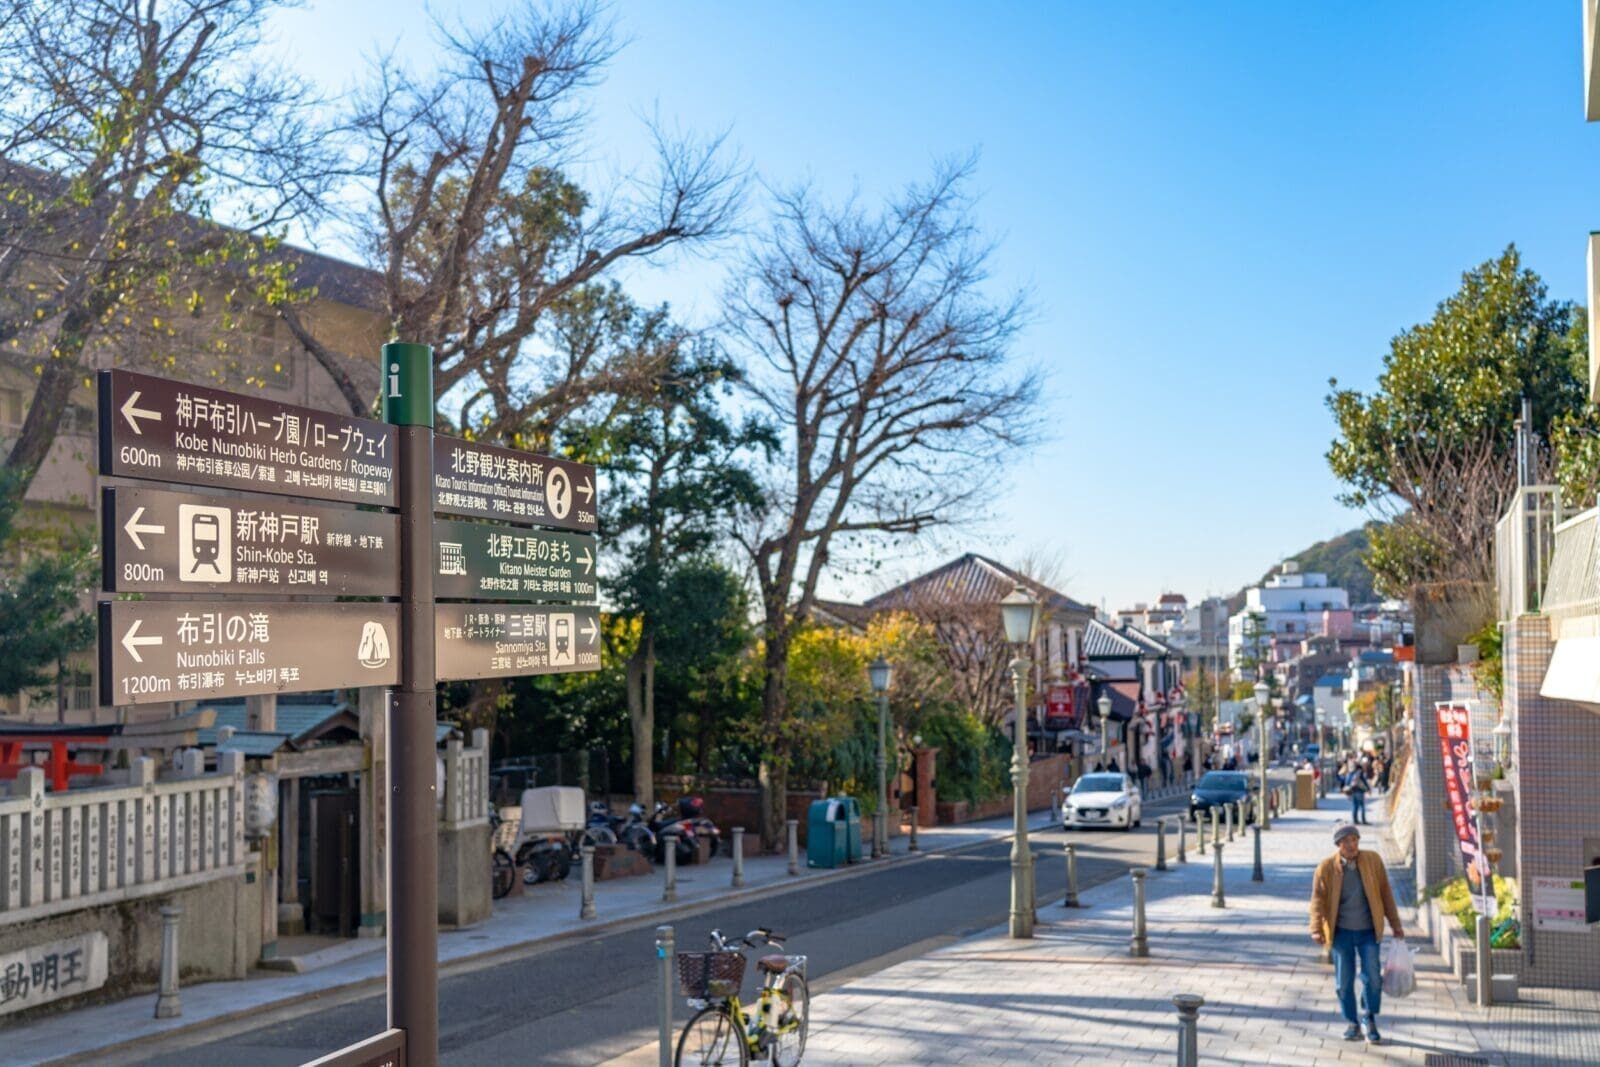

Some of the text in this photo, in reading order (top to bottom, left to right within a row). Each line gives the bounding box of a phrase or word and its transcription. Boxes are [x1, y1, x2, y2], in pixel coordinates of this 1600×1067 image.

[120, 446, 161, 468] 600m
[175, 432, 209, 451] Kobe
[212, 437, 266, 460] Nunobiki
[270, 443, 297, 465] Herb
[300, 451, 342, 472] Gardens
[351, 459, 393, 481] Ropeway
[451, 448, 543, 487] 北野観光案内所
[577, 510, 595, 523] 350m
[236, 509, 320, 545] 新神戸駅
[236, 546, 317, 565] Shin-Kobe Sta.
[487, 533, 572, 563] 北野工房のまち
[124, 563, 164, 582] 800m
[319, 570, 328, 585] 역
[500, 562, 571, 578] Kitano Meister Garden
[574, 582, 594, 594] 1000m
[176, 612, 270, 645] 布引の滝
[510, 614, 547, 637] 三宮駅
[495, 640, 547, 655] Sannomiya Sta.
[177, 649, 265, 668] Nunobiki Falls
[578, 653, 598, 665] 1000m
[122, 676, 171, 694] 1200m
[177, 671, 225, 690] 布引瀑布
[235, 668, 276, 686] 누노비키
